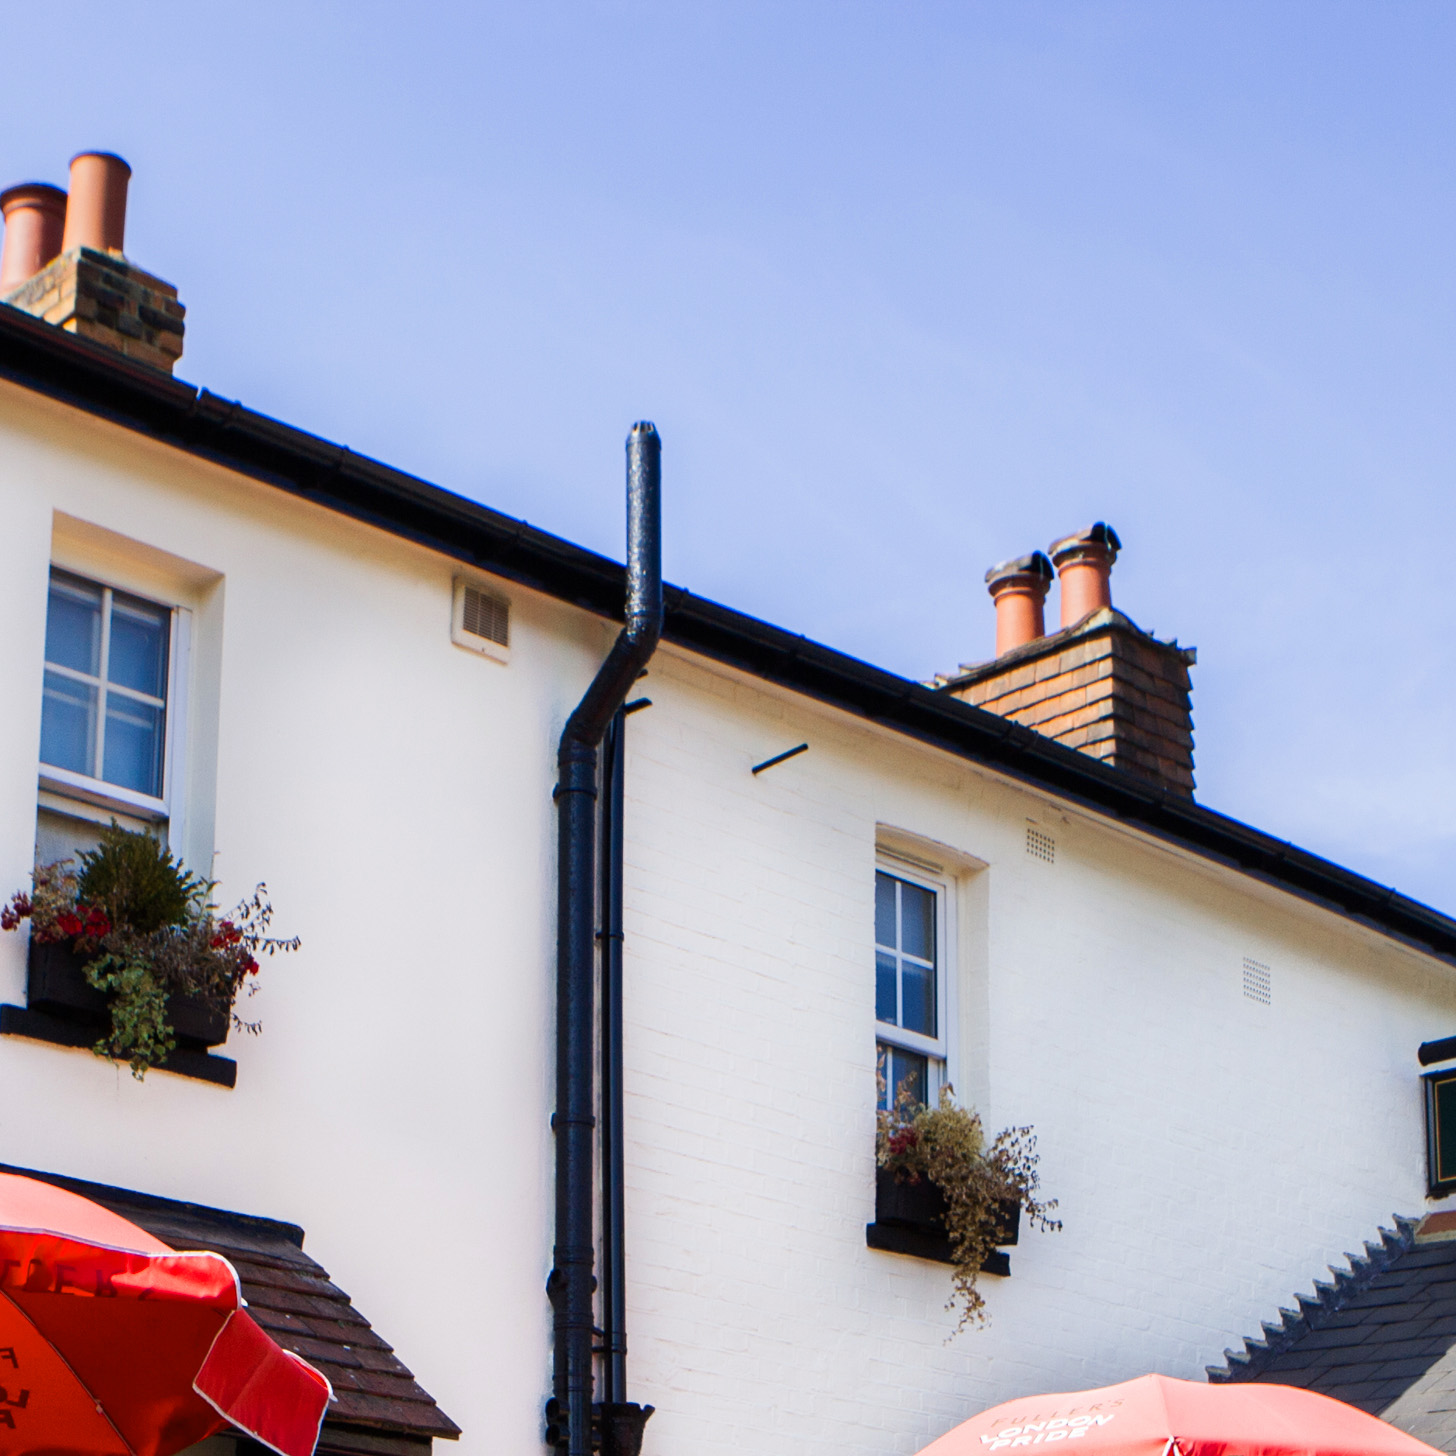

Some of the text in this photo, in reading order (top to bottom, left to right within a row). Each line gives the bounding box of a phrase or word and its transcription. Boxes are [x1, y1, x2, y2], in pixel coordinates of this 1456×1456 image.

[990, 1398, 1125, 1428] FULLER'S
[979, 1414, 1115, 1444] LONDON
[989, 1425, 1090, 1451] PRIDE
